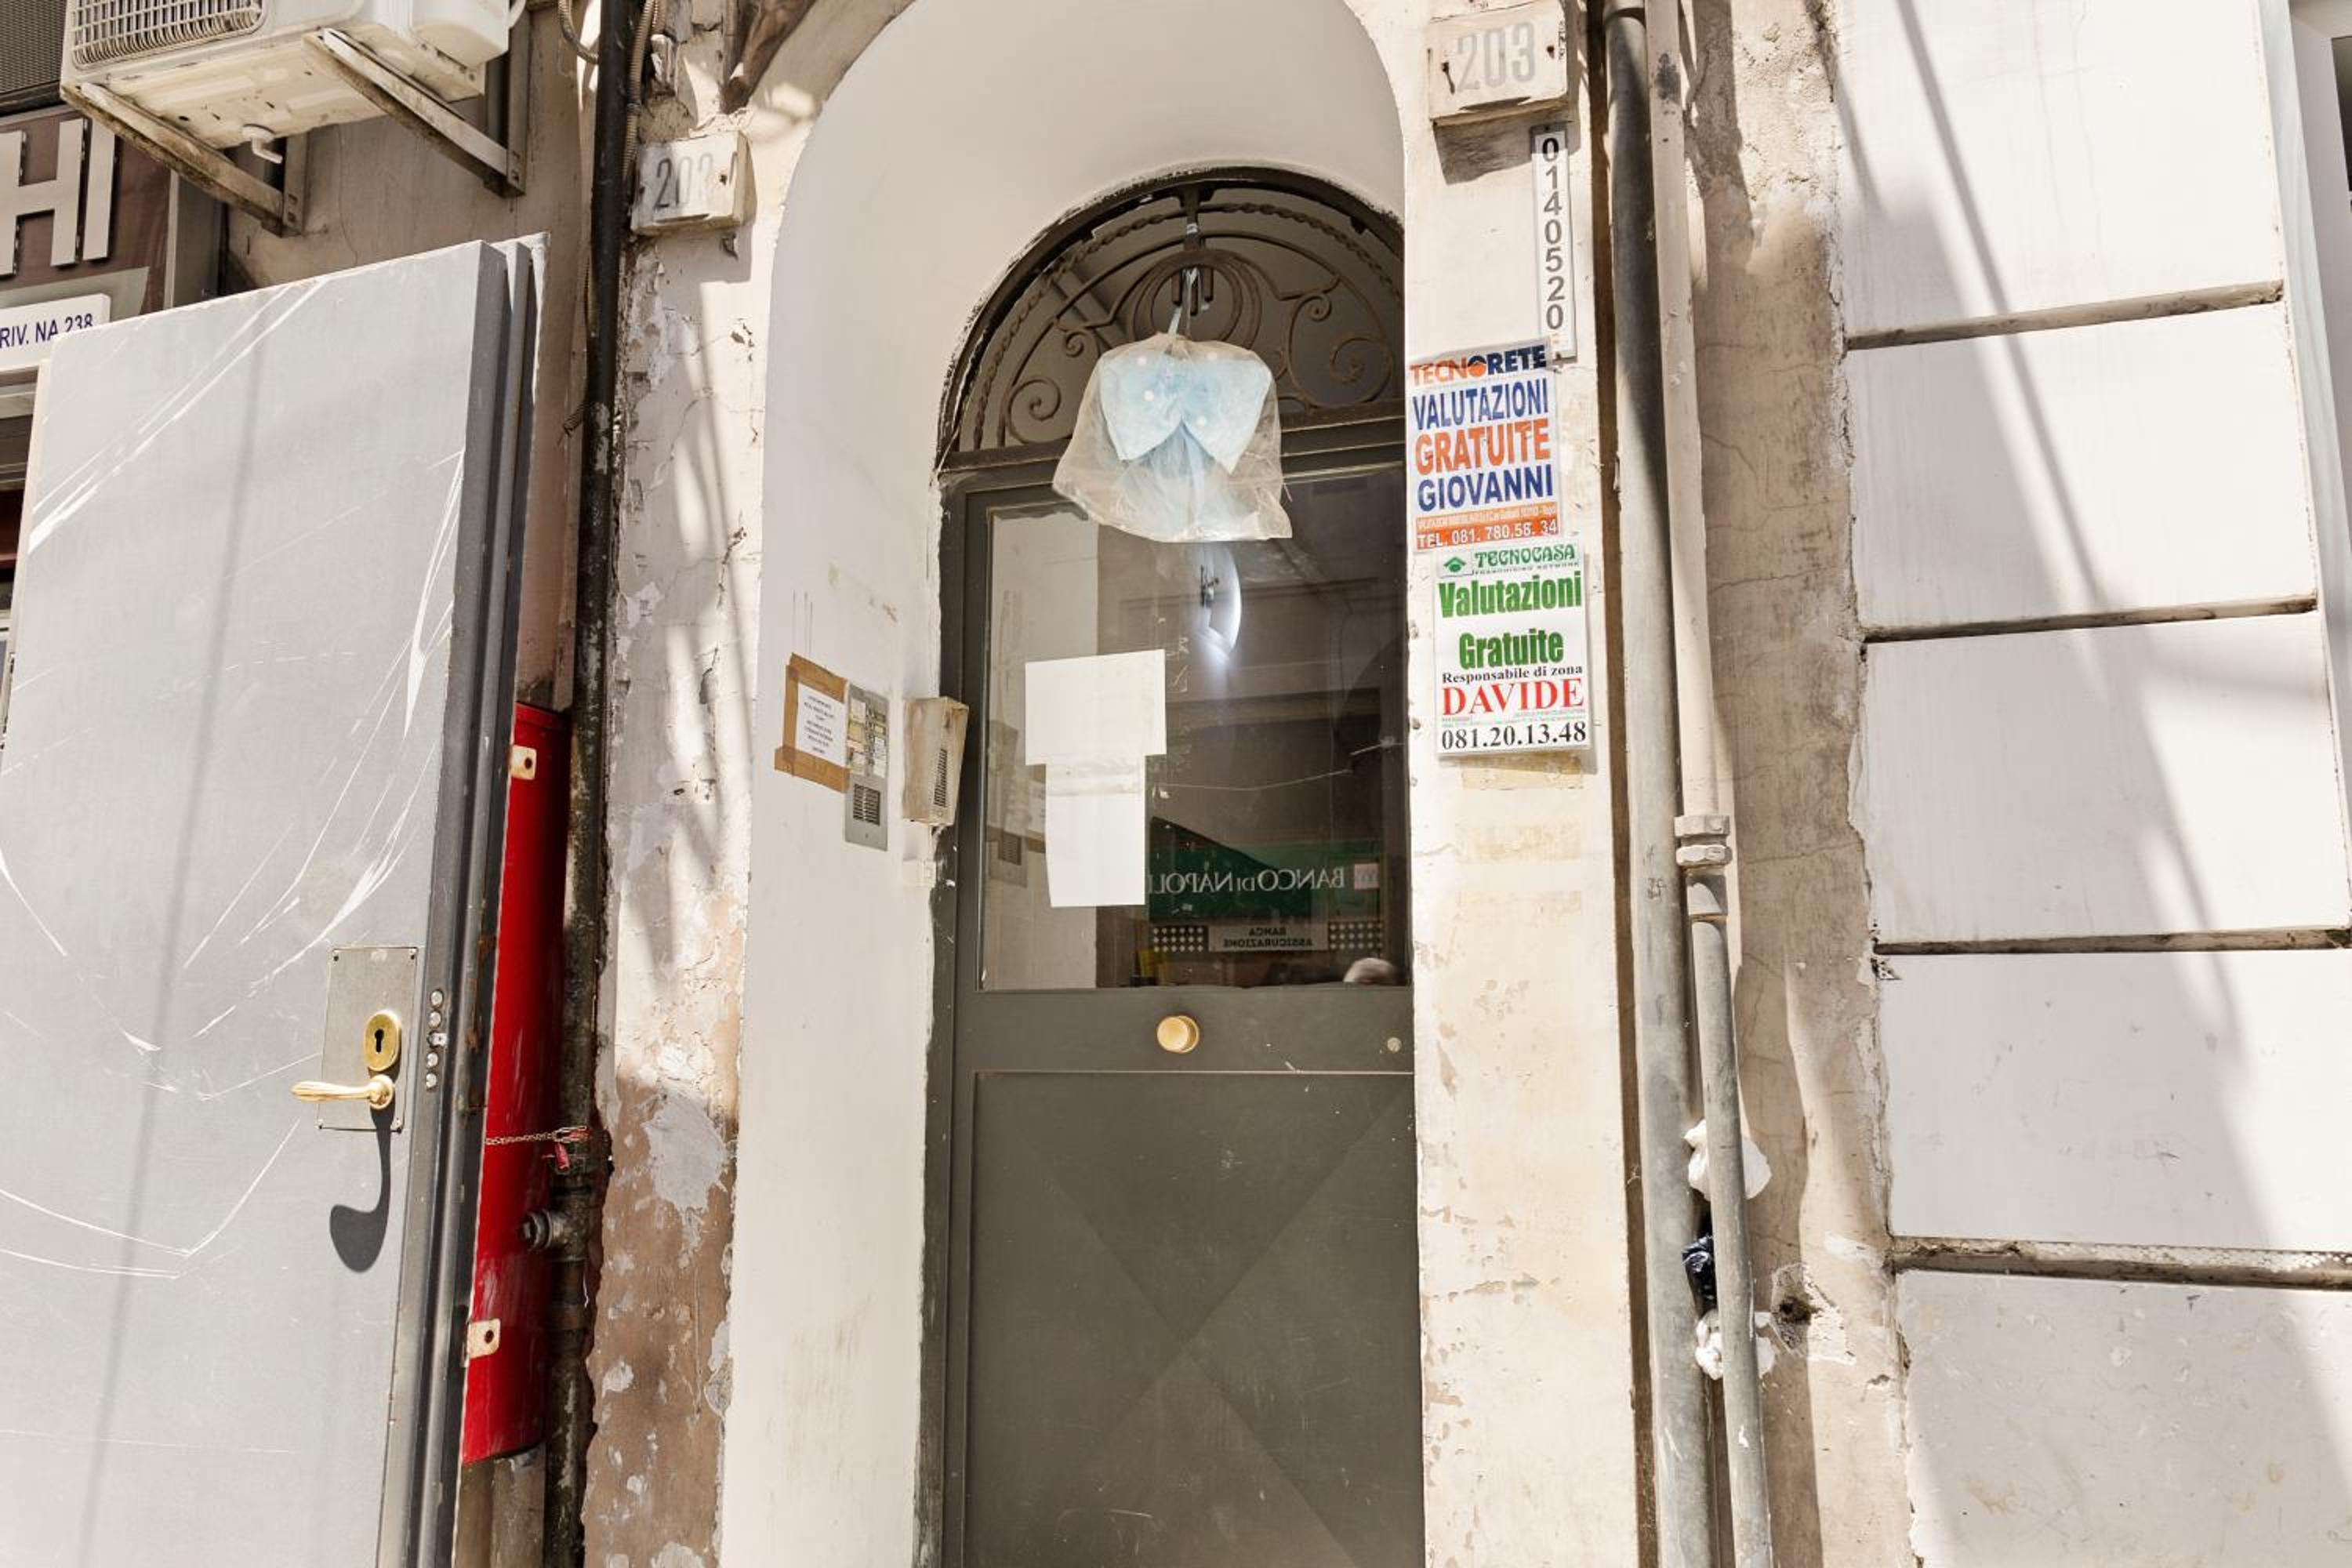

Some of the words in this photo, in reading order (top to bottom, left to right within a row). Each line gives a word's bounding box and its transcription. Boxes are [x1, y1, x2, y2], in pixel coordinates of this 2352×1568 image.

[1456, 21, 1537, 93] 203
[1541, 137, 1566, 330] 0140520
[35, 319, 59, 343] NA
[1410, 345, 1547, 386] TECNORETE
[1413, 378, 1548, 430] VALUTAZIONI
[1415, 418, 1551, 475] GRATUITE
[1417, 464, 1553, 512] GIOVANNI
[1475, 544, 1575, 568] TECNOCASA
[1439, 570, 1581, 618] Valutazioni
[1459, 628, 1563, 670] Gratuite
[1442, 667, 1530, 684] Responsabile
[1534, 666, 1547, 678] di
[1551, 666, 1583, 677] zona
[1443, 677, 1584, 716] DAVIDE
[1442, 720, 1586, 750] 081.20.13.48
